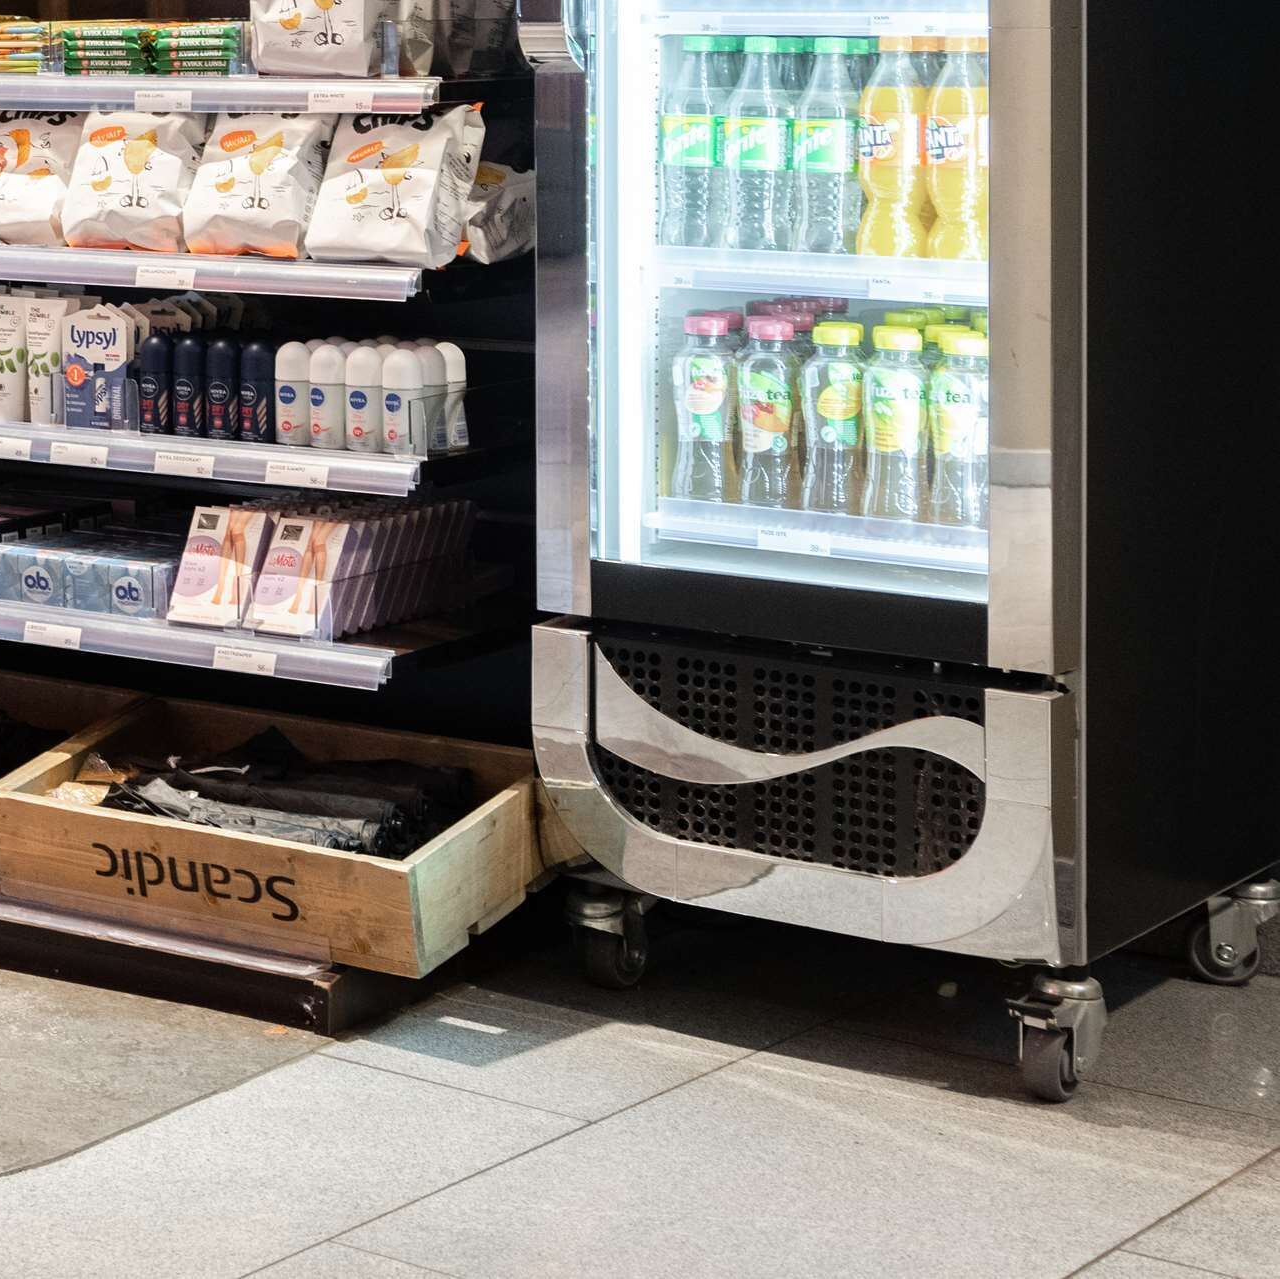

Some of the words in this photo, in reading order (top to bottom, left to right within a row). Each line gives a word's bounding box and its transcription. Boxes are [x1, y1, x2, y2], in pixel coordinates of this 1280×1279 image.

[767, 388, 792, 402] tea
[903, 387, 927, 401] tea
[945, 390, 971, 404] tea
[113, 386, 121, 420] ORIGINAL
[24, 571, 52, 591] o.b.
[92, 843, 300, 922] Scandic
